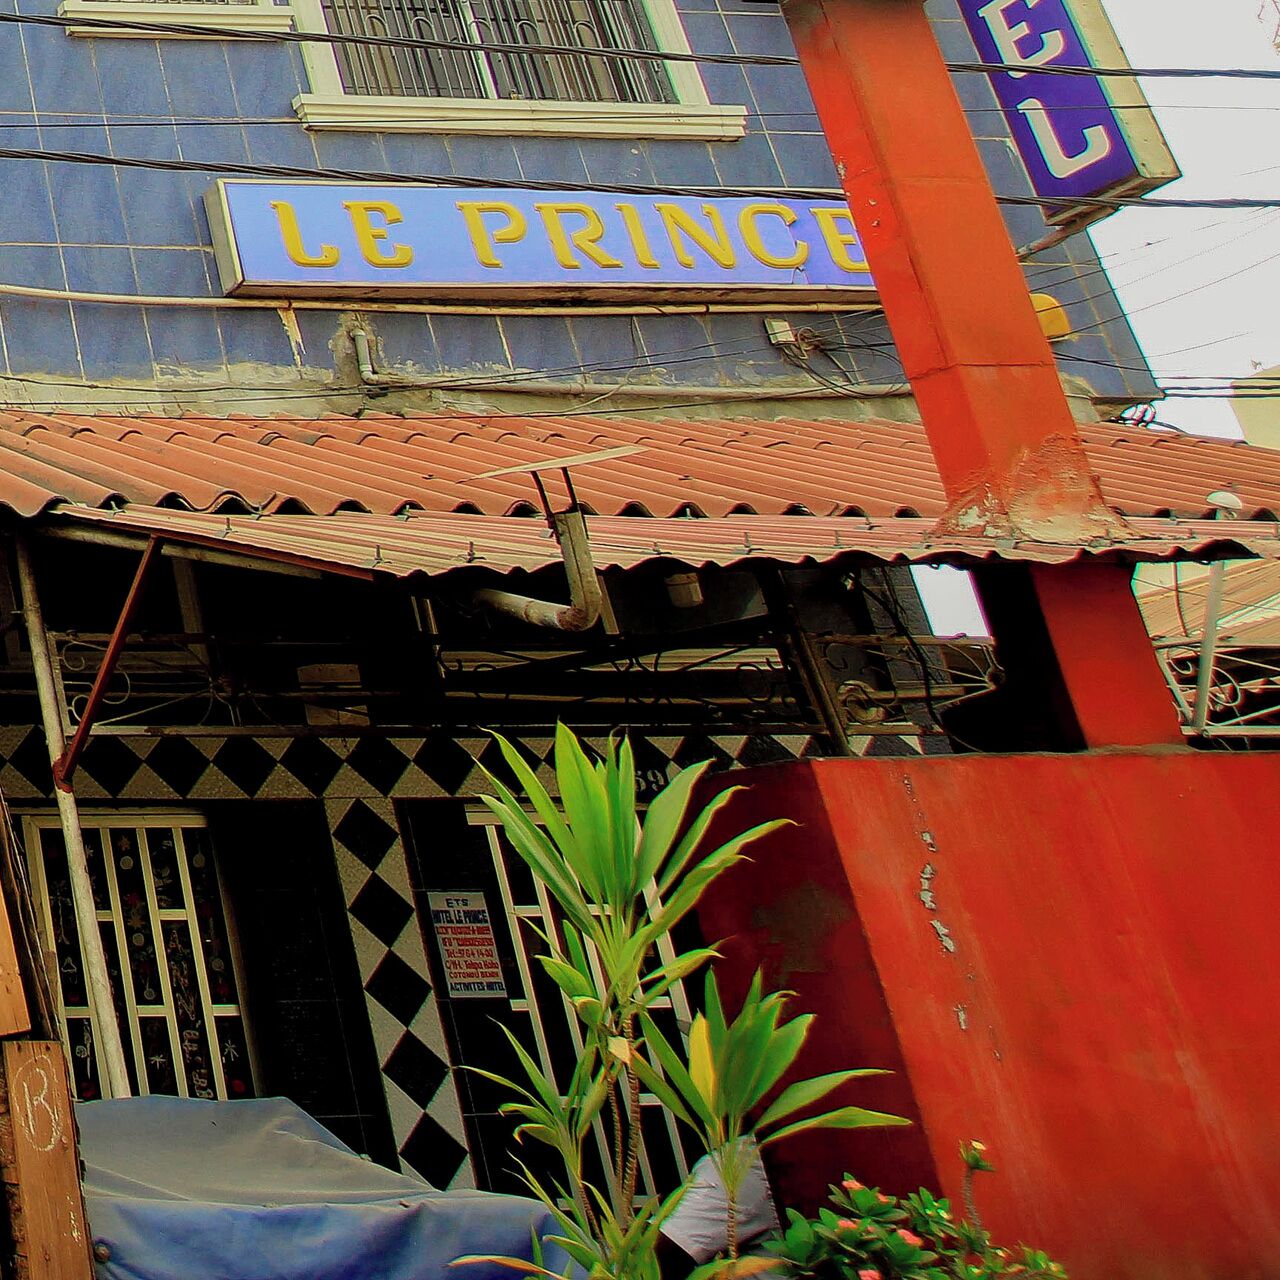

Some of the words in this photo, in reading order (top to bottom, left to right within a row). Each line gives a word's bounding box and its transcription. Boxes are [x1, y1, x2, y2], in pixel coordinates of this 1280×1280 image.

[269, 199, 415, 269] LE
[456, 200, 870, 273] PRINCE
[446, 898, 469, 908] ETS
